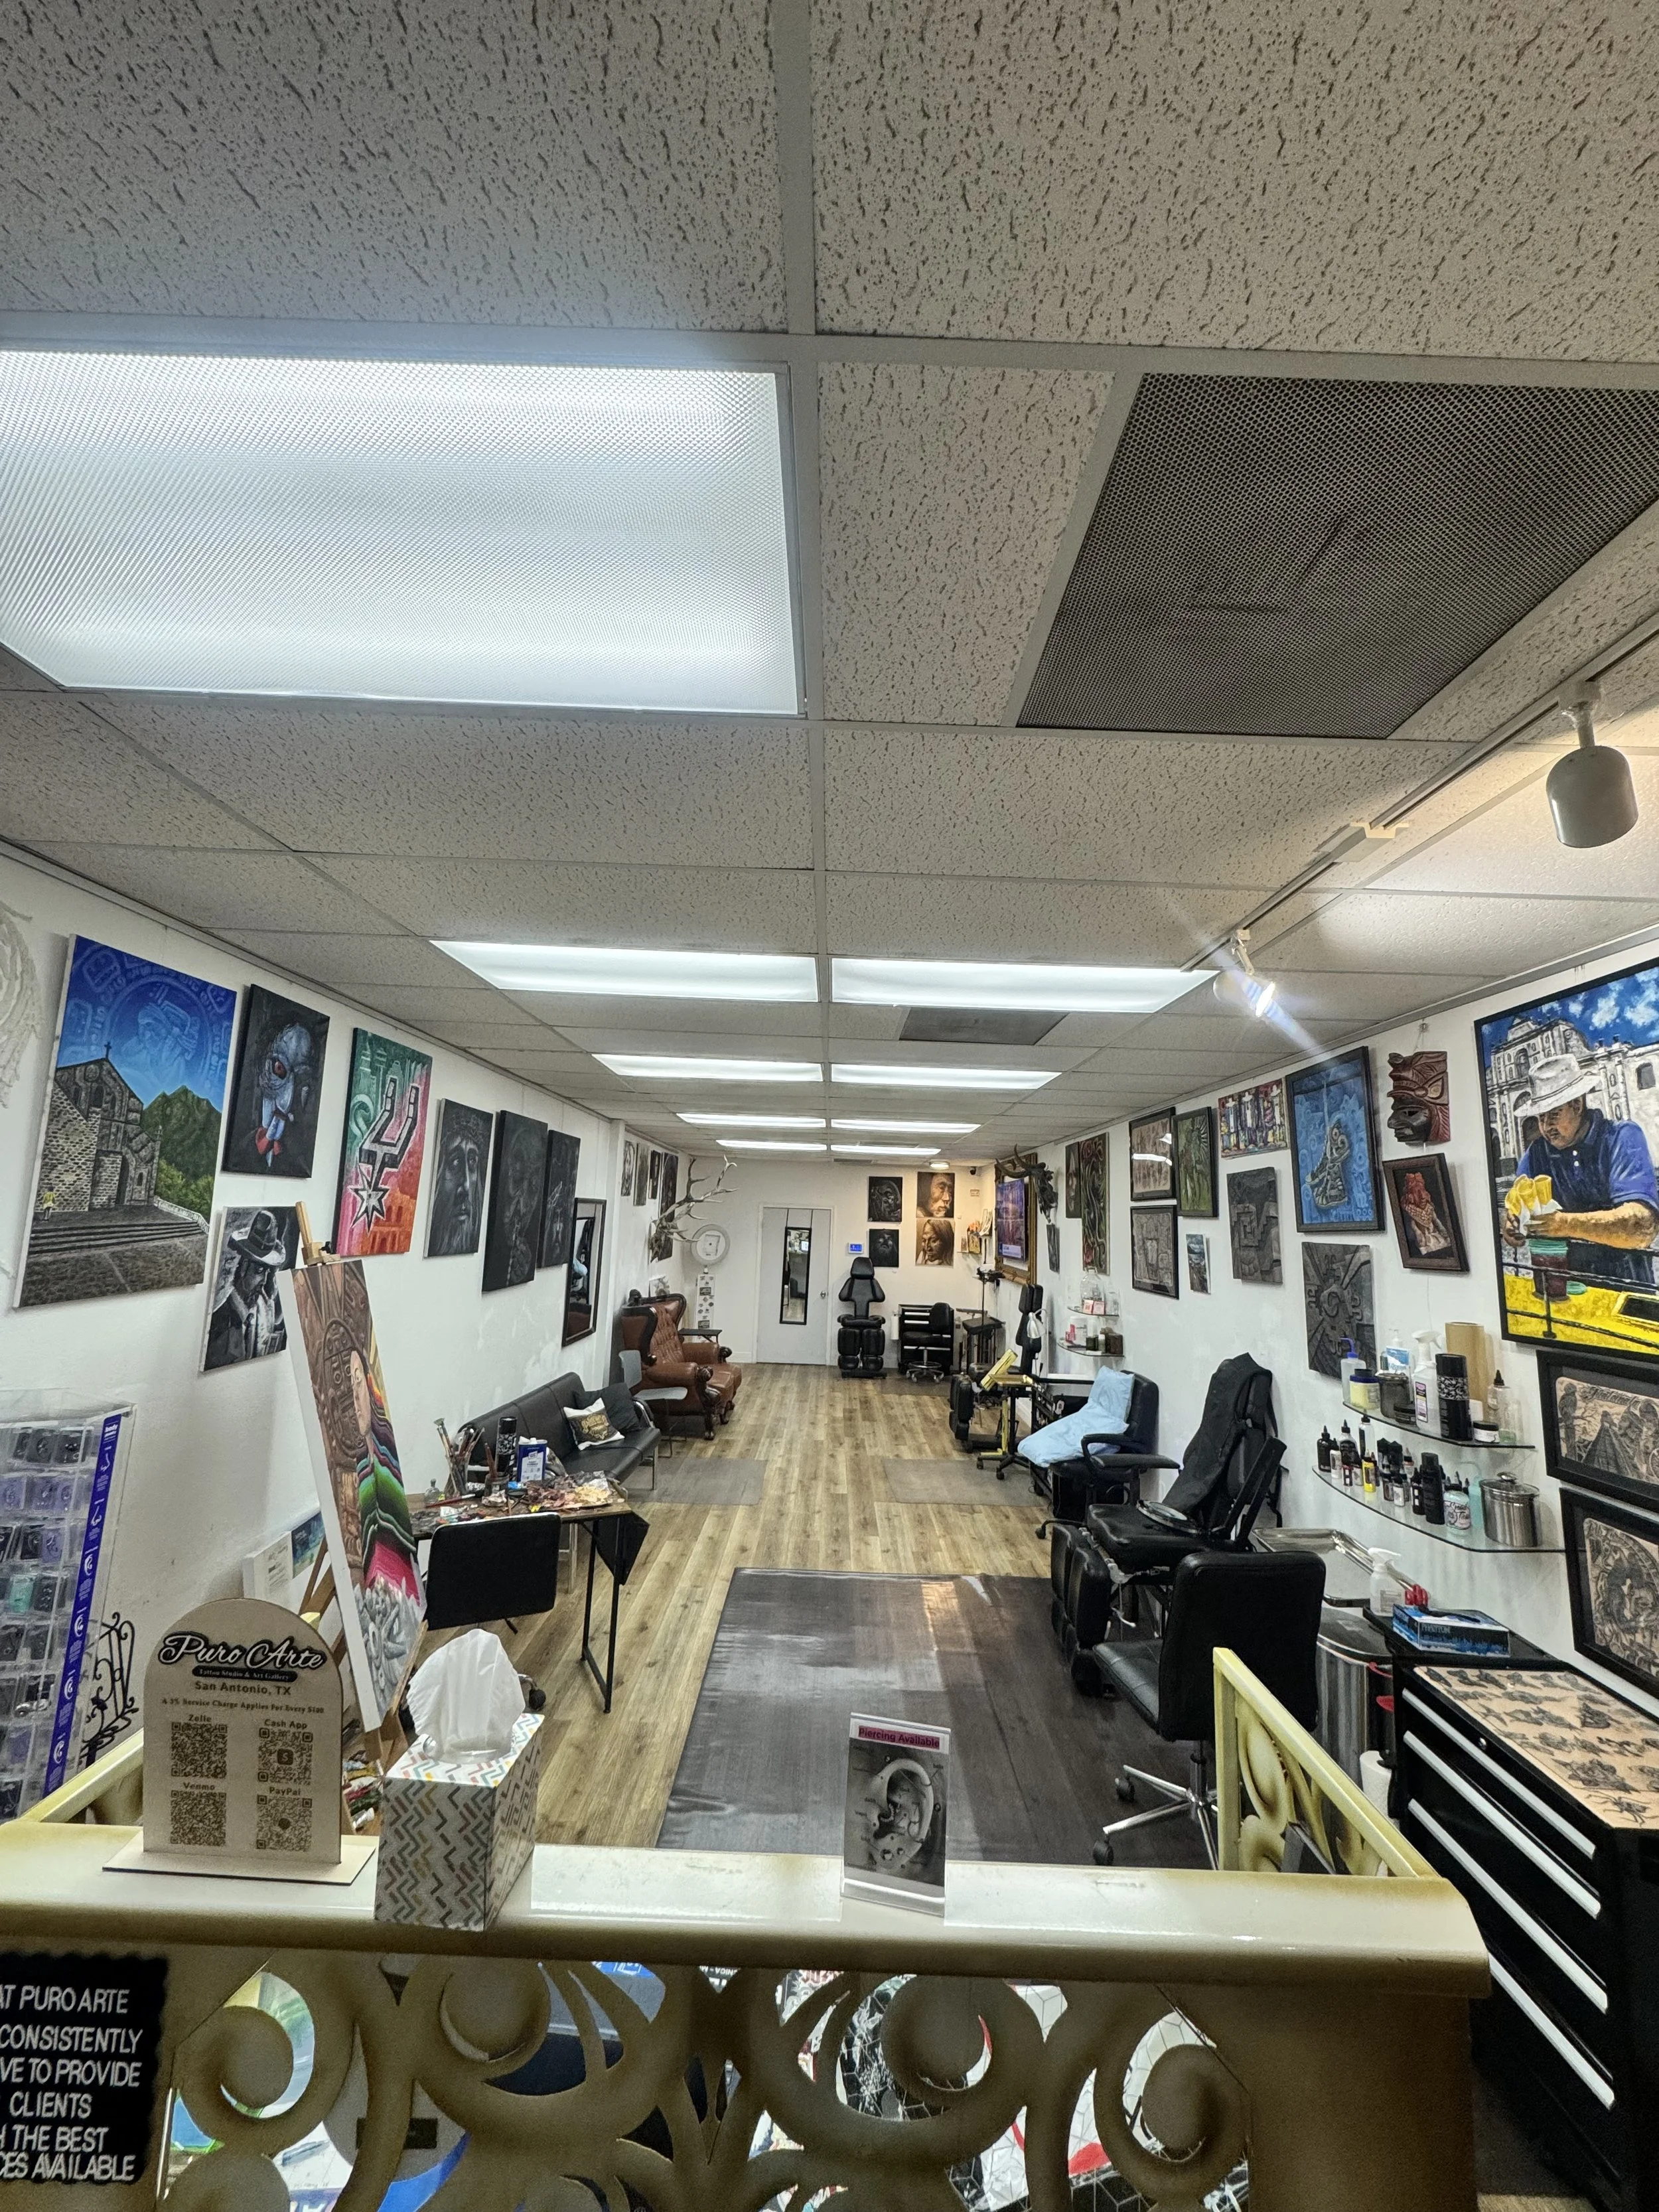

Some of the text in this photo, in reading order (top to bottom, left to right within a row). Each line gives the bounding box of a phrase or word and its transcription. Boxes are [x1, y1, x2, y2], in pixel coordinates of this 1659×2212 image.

[159, 1634, 324, 1668] Puro Arte
[194, 1681, 292, 1696] San Antonio, TX
[265, 1718, 307, 1730] Cash App
[859, 1726, 940, 1748] Piercing Available
[183, 1782, 215, 1791] Venmo
[269, 1787, 301, 1796] PayPal
[19, 1984, 77, 2012] PURO
[77, 1987, 130, 2014] ARTE
[0, 2024, 143, 2054] CONSISTENTLY
[29, 2057, 52, 2084] TO
[54, 2059, 142, 2087] PROVIDE
[9, 2091, 93, 2119] CLIENTS
[12, 2124, 52, 2152] THE
[55, 2126, 109, 2154] BEST
[31, 2152, 136, 2181] AVAILABLE
